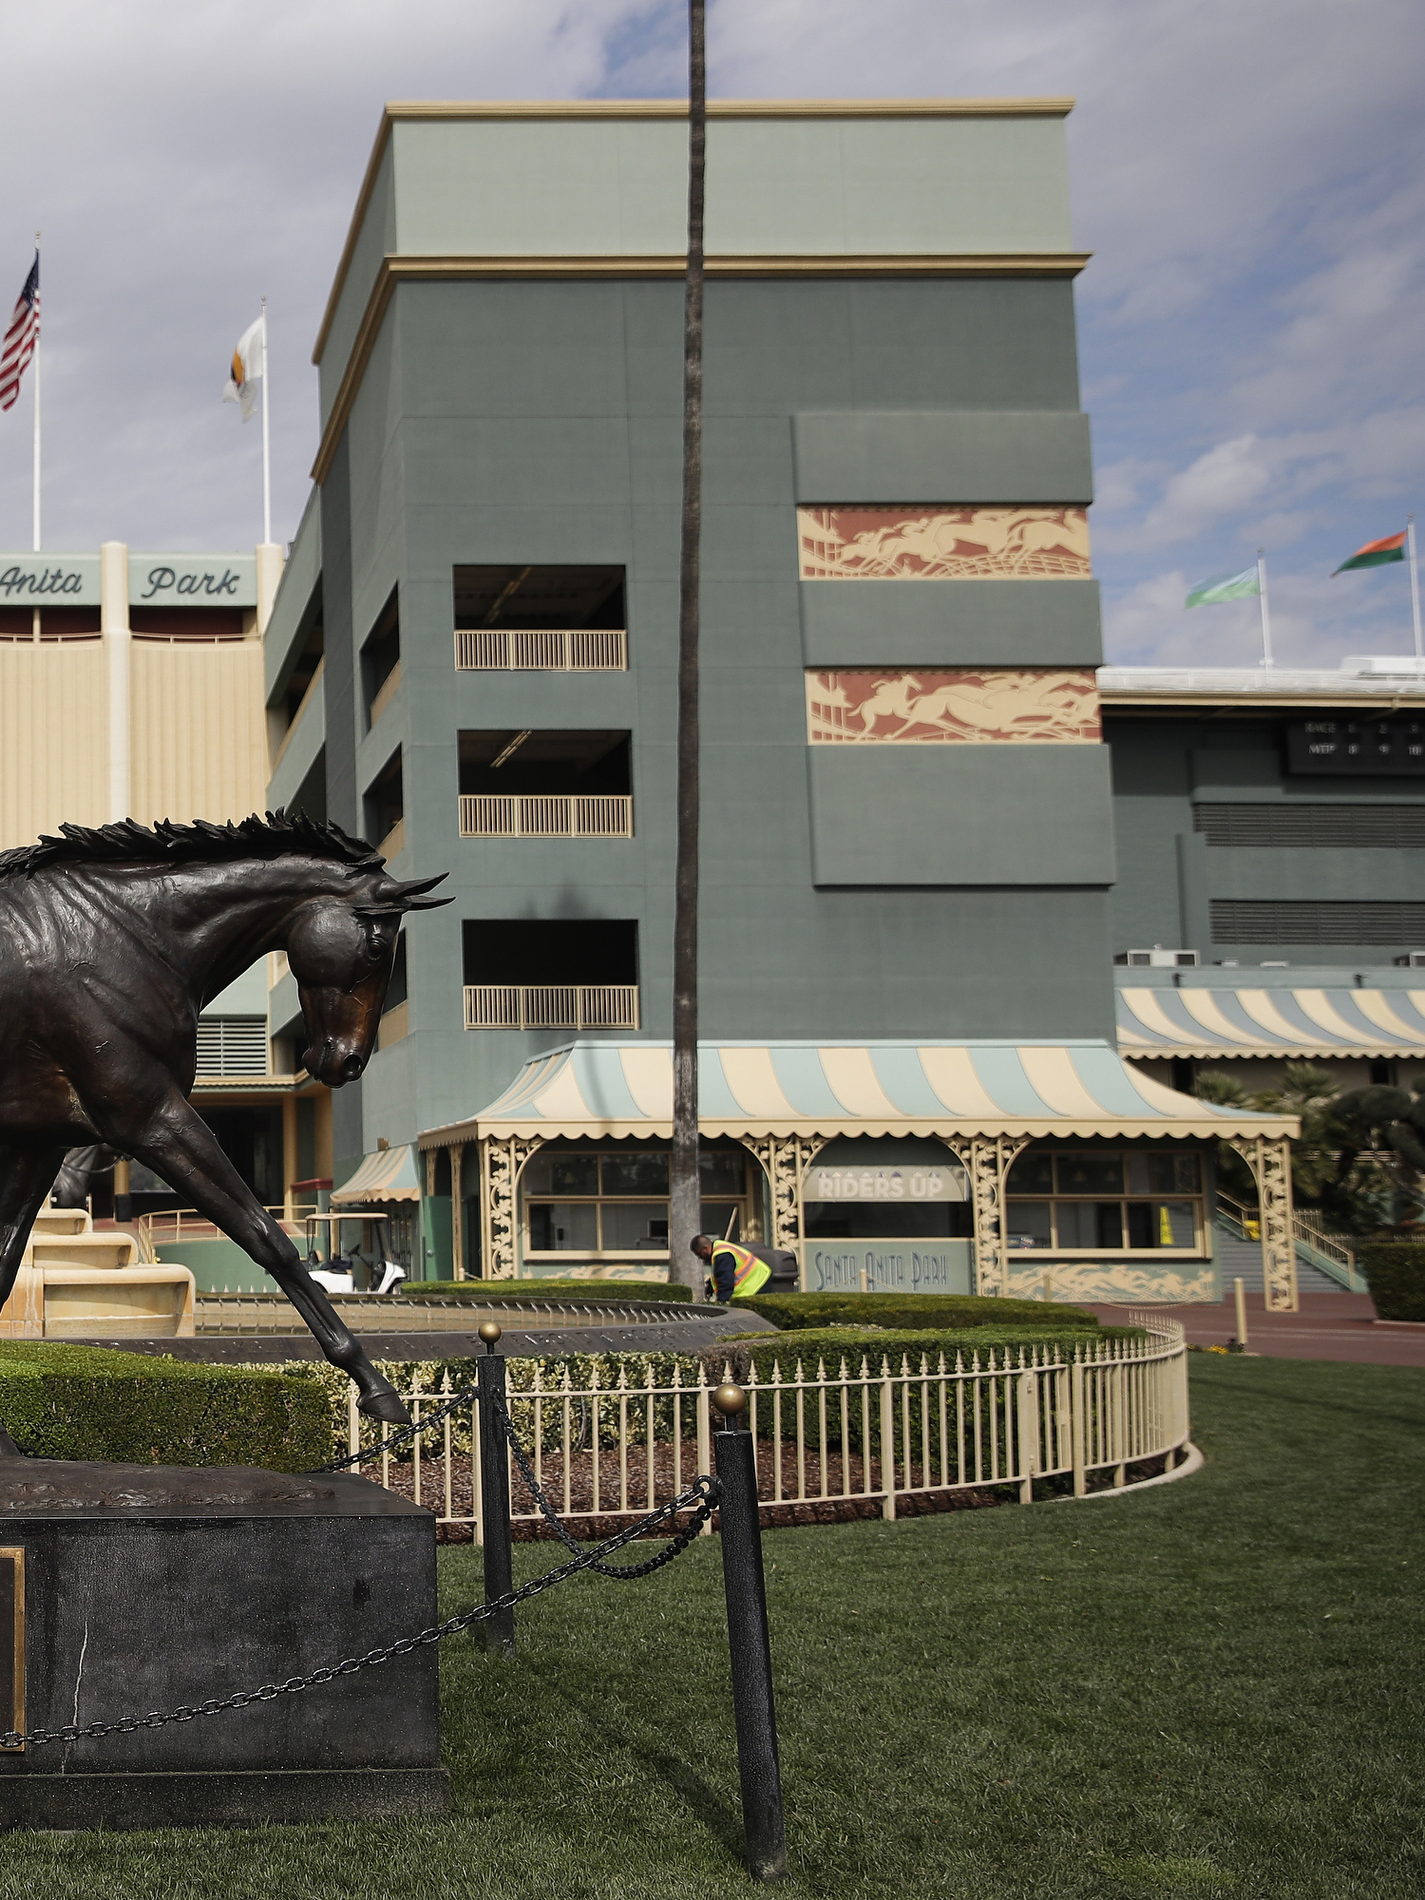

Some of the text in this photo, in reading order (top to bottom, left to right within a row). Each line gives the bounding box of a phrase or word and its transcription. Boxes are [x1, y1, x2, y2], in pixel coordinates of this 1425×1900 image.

[140, 567, 241, 598] Park
[817, 1177, 944, 1199] RIDERS UP
[909, 1251, 949, 1292] PARK
